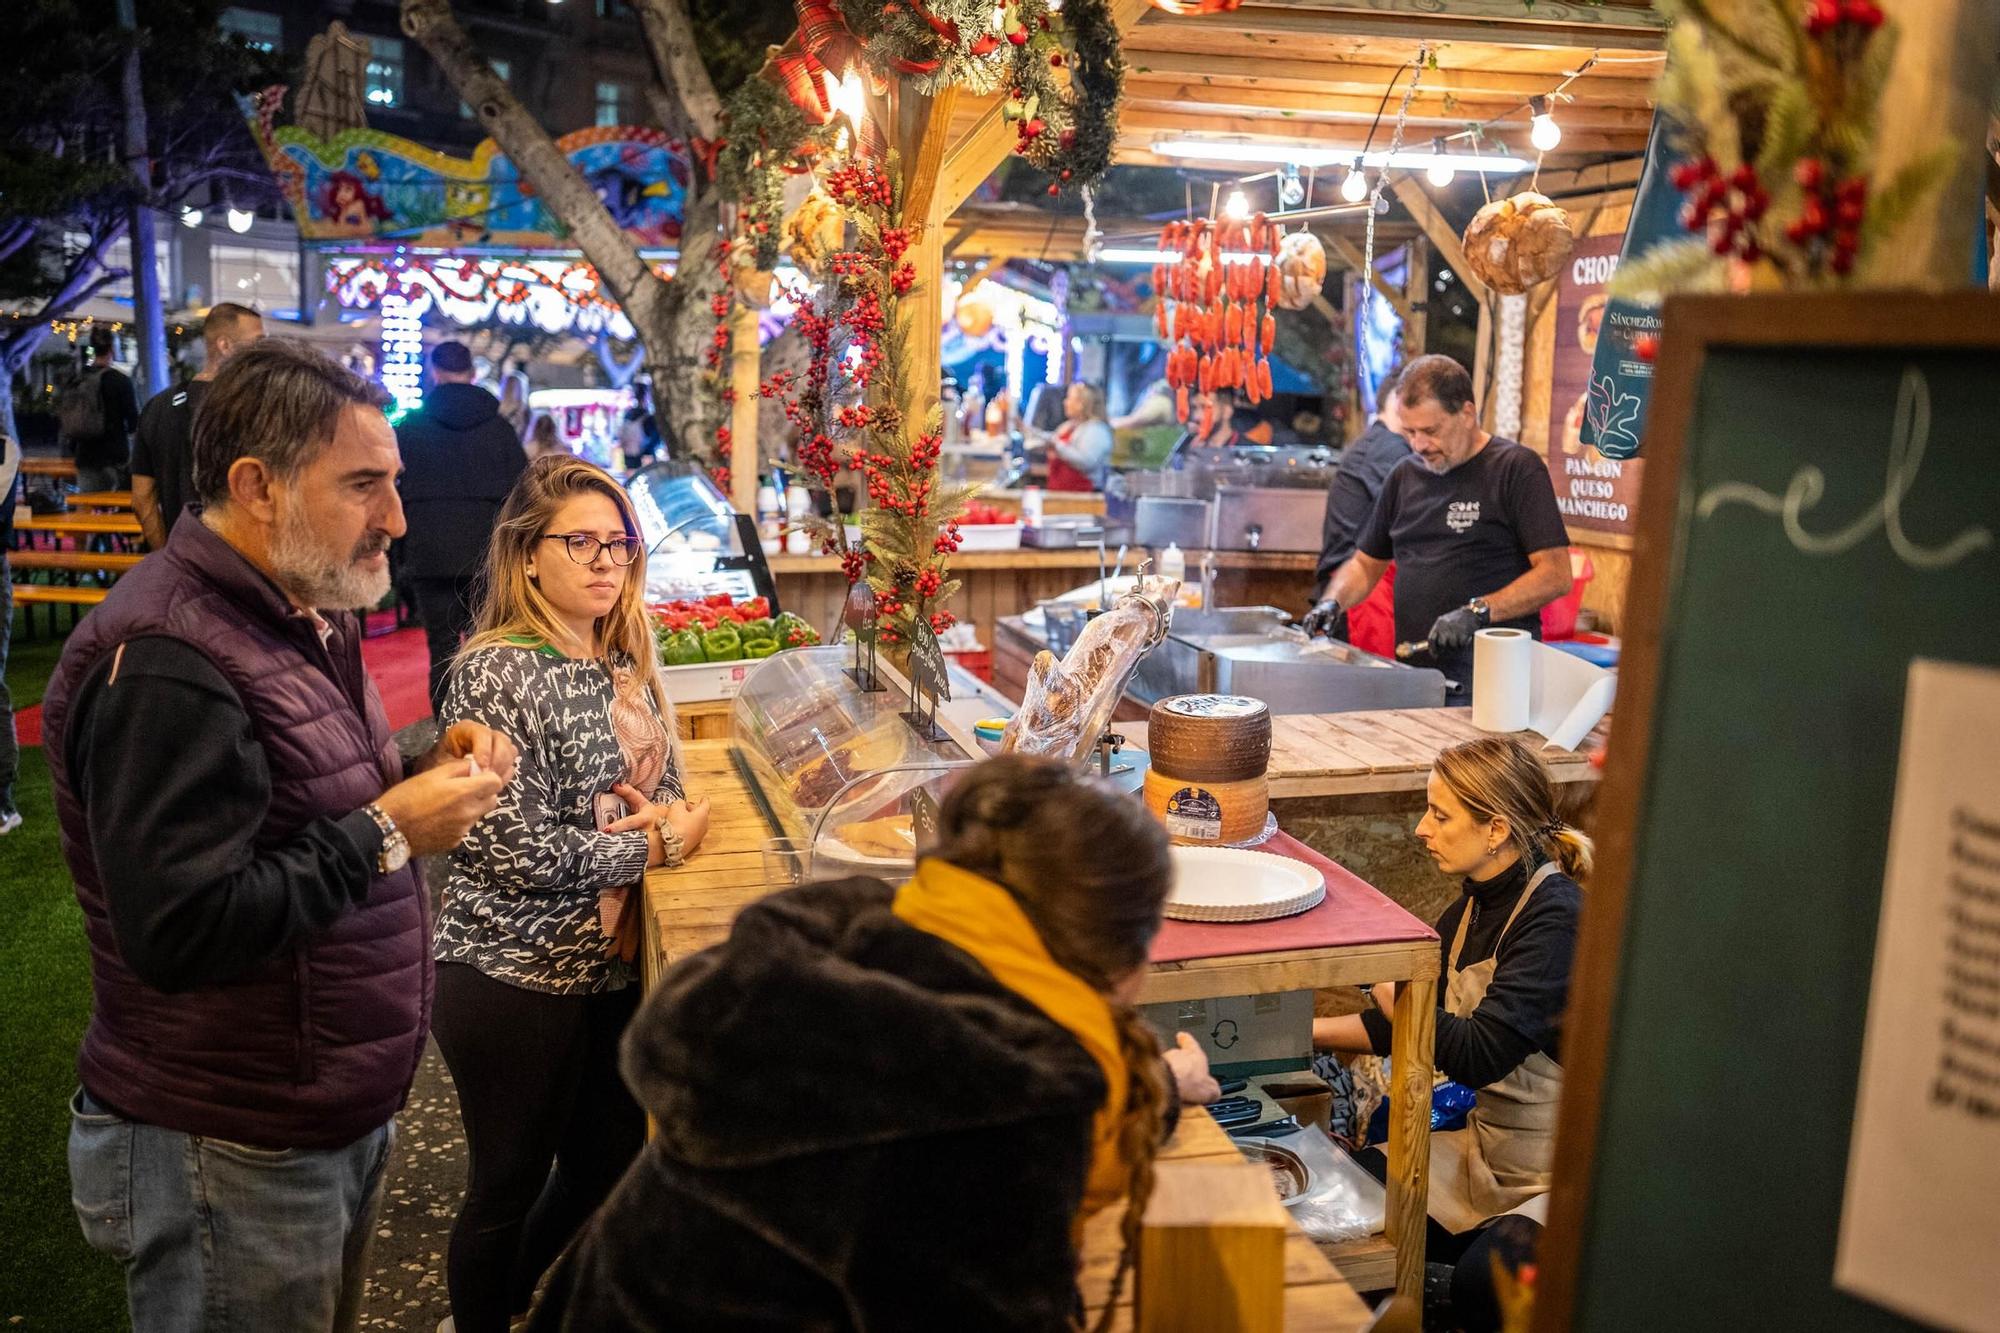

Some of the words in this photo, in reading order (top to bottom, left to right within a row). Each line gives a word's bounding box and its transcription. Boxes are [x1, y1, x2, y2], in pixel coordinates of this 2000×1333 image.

[1565, 458, 1590, 475] PAN
[1594, 461, 1621, 478] CON
[1571, 479, 1613, 499] QUESO
